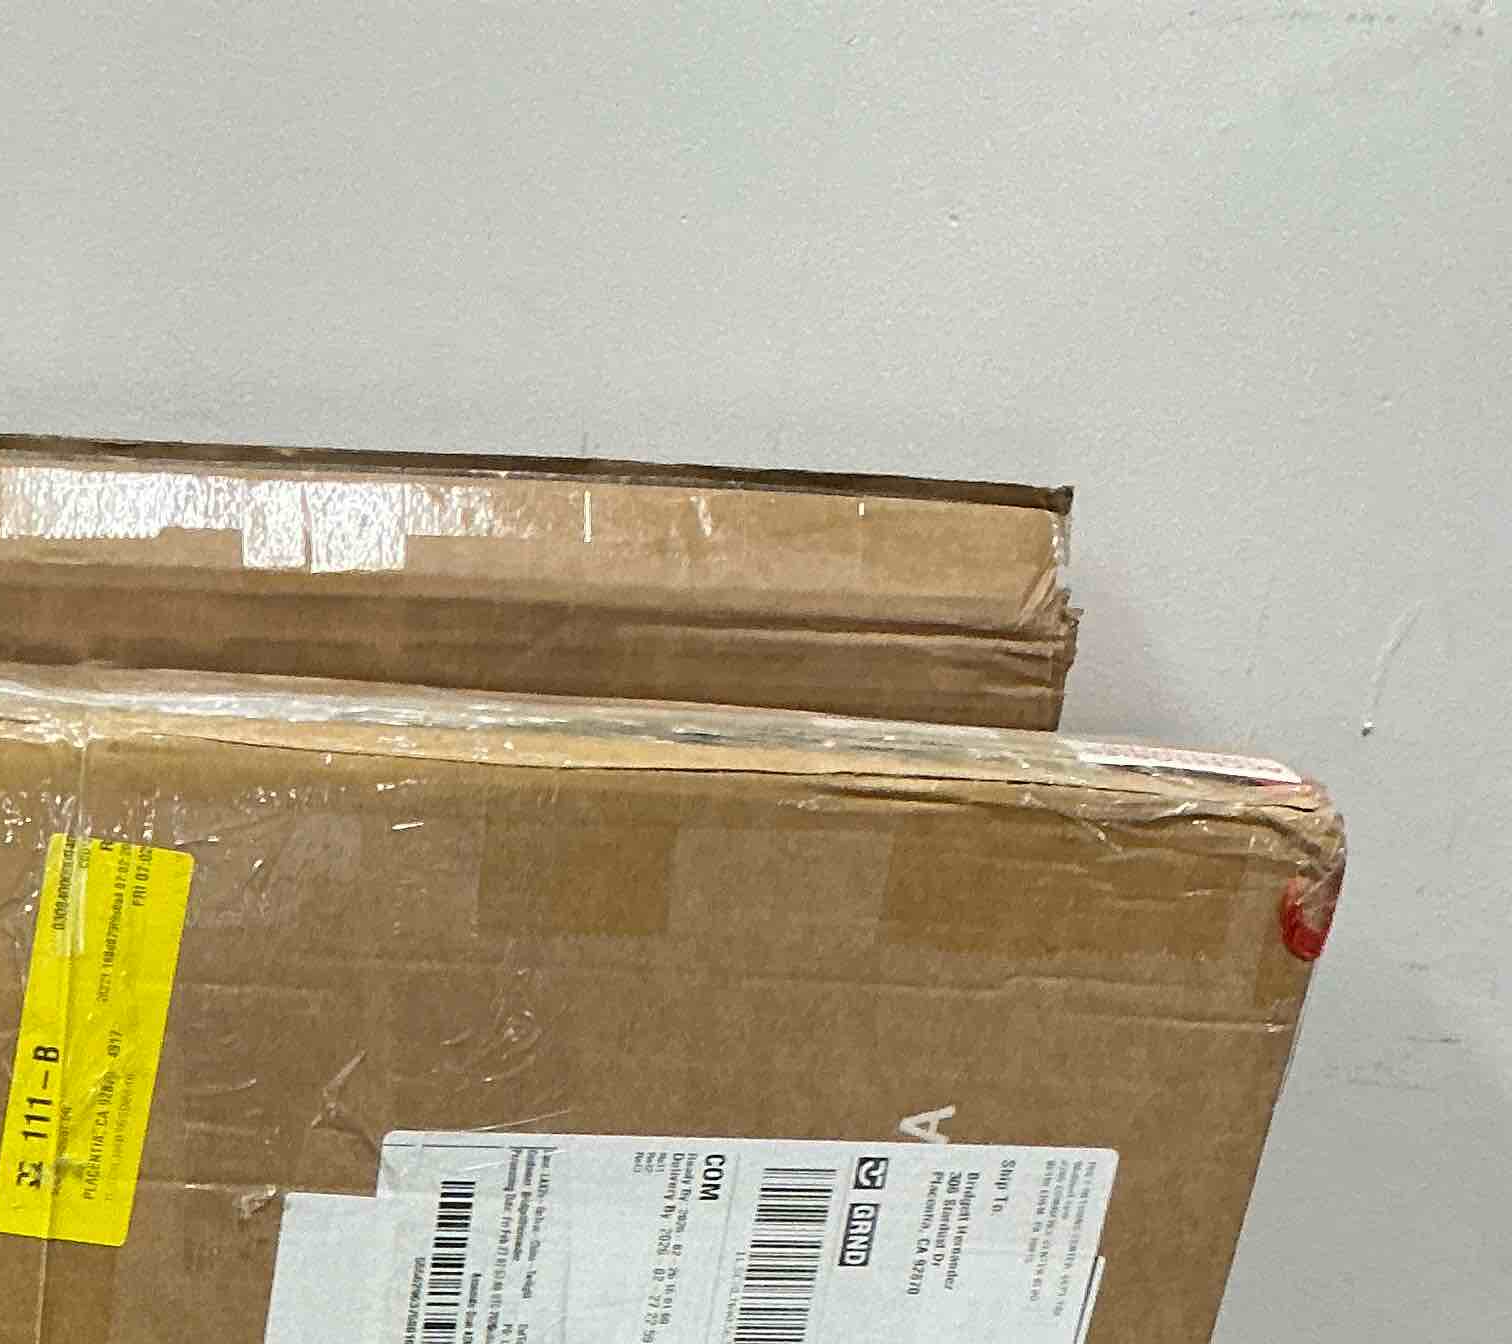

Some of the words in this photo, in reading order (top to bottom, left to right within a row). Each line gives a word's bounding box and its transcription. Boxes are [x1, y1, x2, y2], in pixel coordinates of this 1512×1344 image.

[698, 1154, 726, 1201] COM
[844, 1205, 877, 1265] GRND
[915, 1238, 930, 1253] CA
[906, 1258, 925, 1295] 92870
